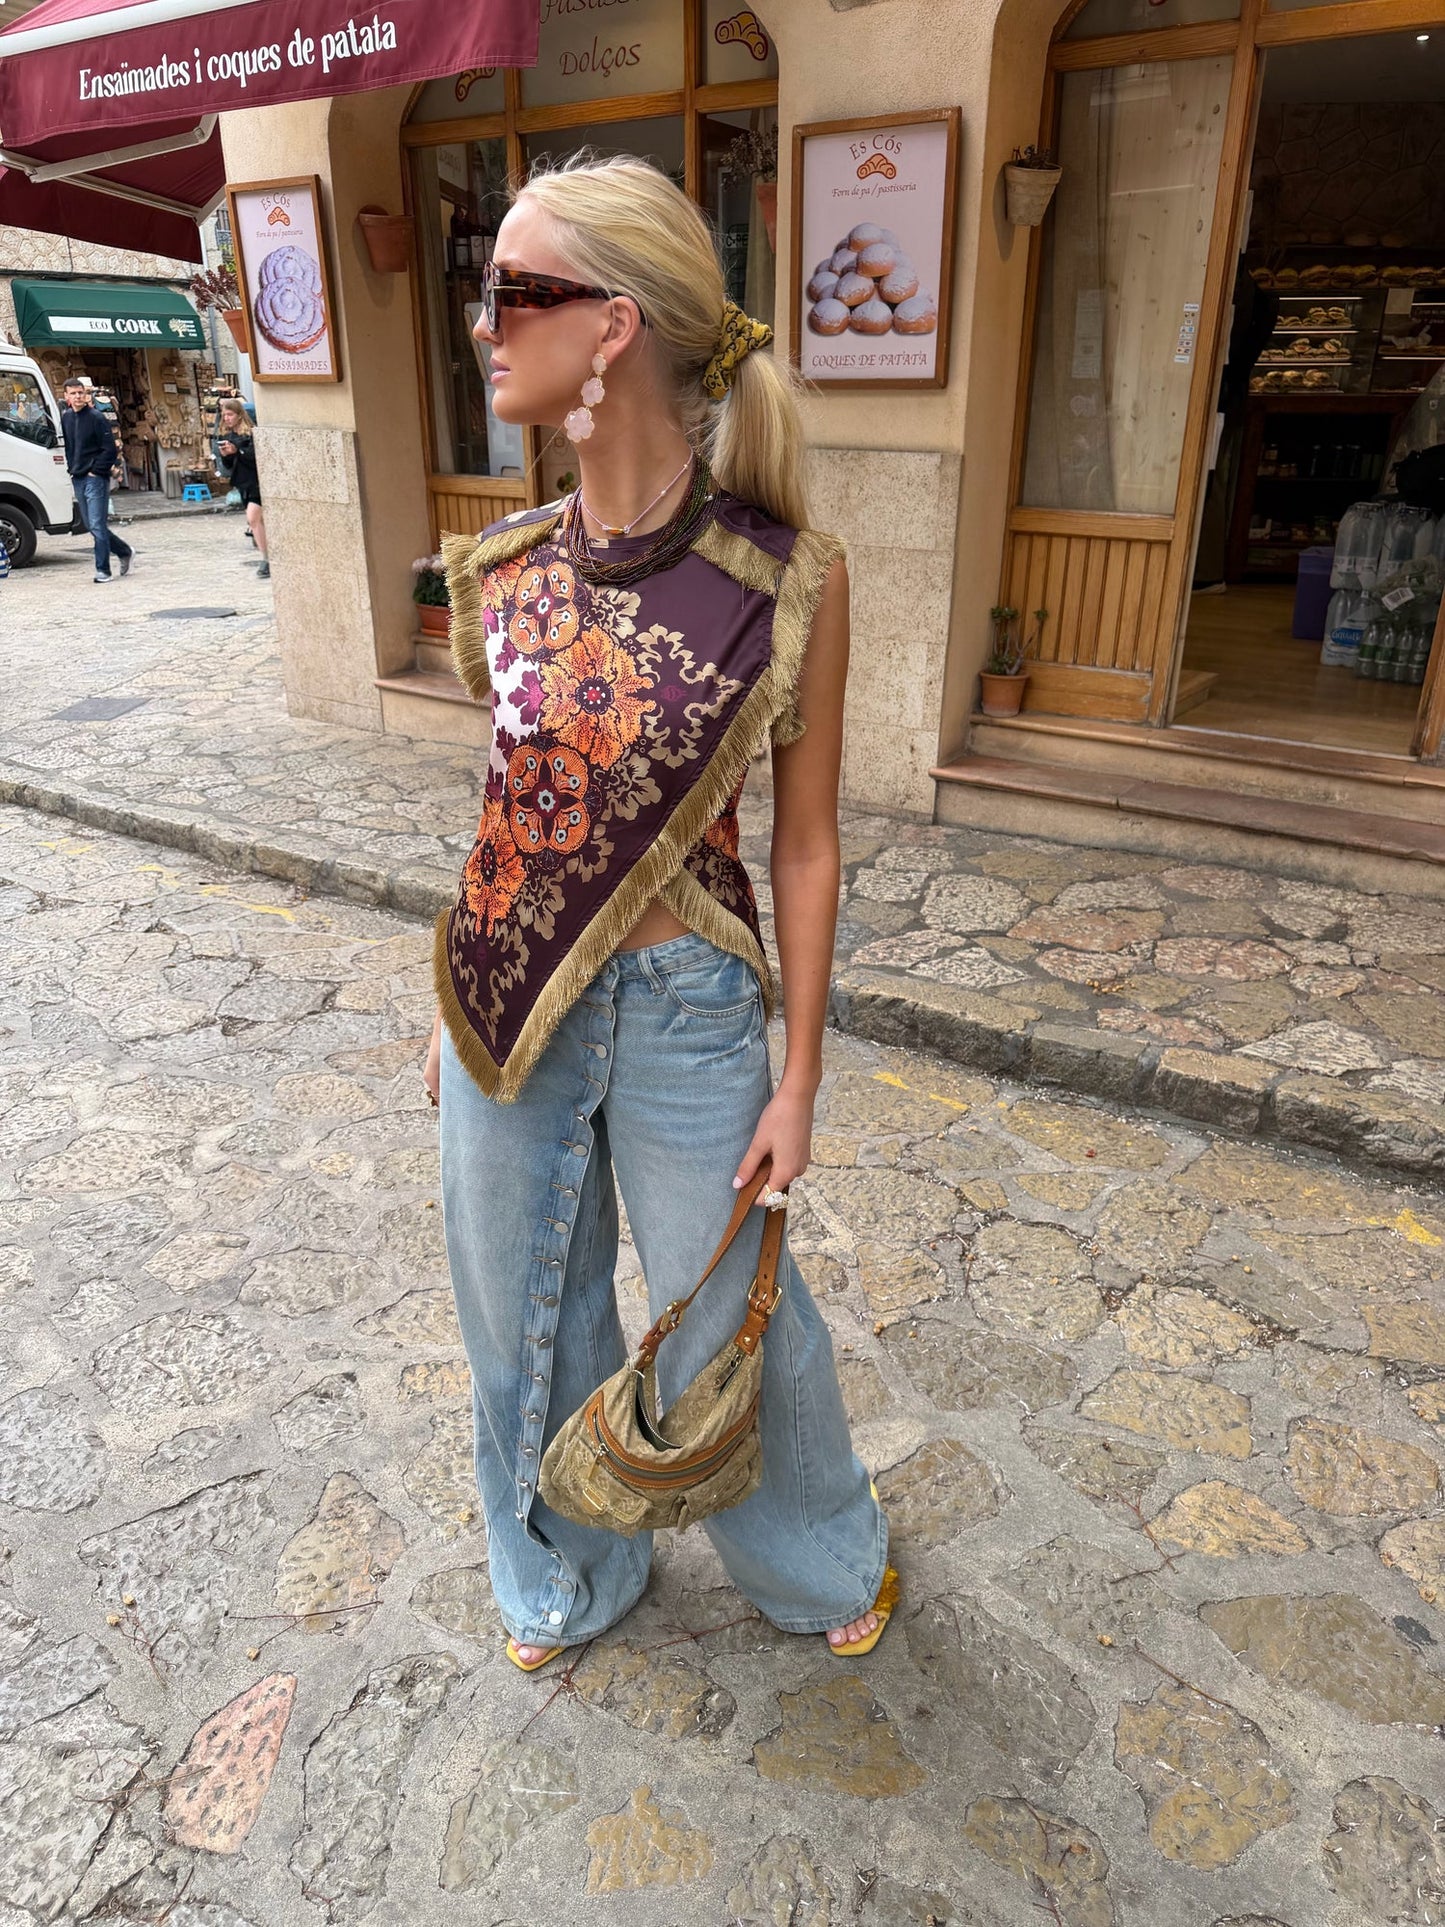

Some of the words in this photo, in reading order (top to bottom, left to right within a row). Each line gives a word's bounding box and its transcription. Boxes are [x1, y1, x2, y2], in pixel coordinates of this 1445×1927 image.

[79, 53, 190, 100] Ensaïmades
[193, 47, 203, 83] i
[207, 43, 282, 88] coques
[287, 27, 316, 67] de
[320, 14, 397, 74] patata
[559, 36, 642, 78] Dolços
[89, 320, 109, 330] ECO
[115, 318, 162, 334] CORK
[811, 354, 856, 369] COQUES
[858, 354, 876, 367] DE
[878, 350, 928, 366] PATATA
